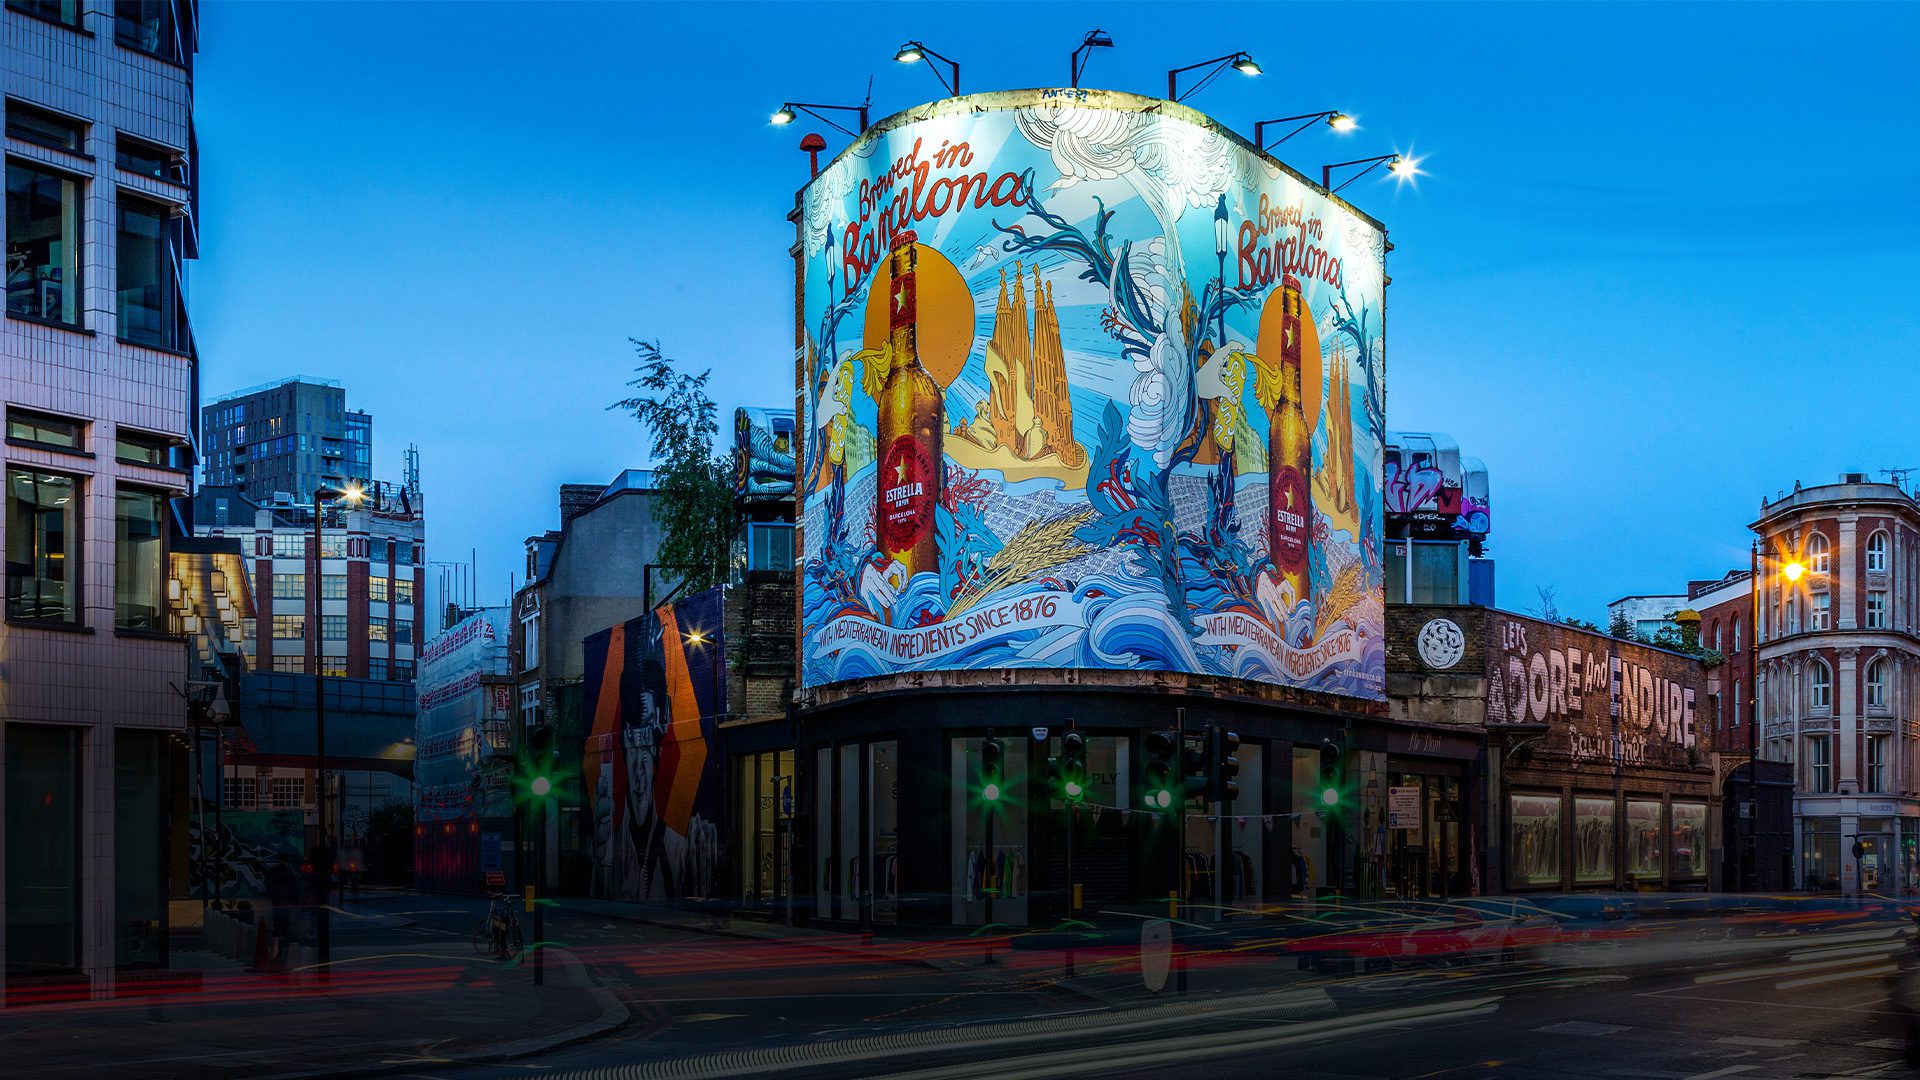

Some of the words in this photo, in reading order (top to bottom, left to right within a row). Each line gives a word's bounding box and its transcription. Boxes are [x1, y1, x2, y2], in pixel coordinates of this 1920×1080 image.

[859, 137, 922, 222] Brewed
[933, 140, 974, 168] in
[841, 160, 1031, 303] Barcelona
[1256, 193, 1304, 237] Brewed
[1308, 212, 1323, 241] in
[1234, 220, 1342, 291] Barcelona
[886, 482, 923, 503] ESTRELLA
[889, 509, 916, 521] BARCELONA
[1277, 509, 1304, 528] ESTRELLA
[820, 626, 834, 648] WITH
[834, 620, 889, 653] MEDITERRANEAN
[890, 623, 966, 659] INGREDIENTS
[966, 606, 1011, 639] SINCE
[1009, 594, 1061, 623] 1876
[1205, 616, 1227, 637] WITH
[1228, 615, 1285, 665] MEDITERRANEAN
[1284, 648, 1321, 677] INGREDIENTS
[1320, 639, 1337, 665] SINCE
[1336, 633, 1352, 654] 1876
[1488, 647, 1582, 723] ADORE
[1610, 656, 1696, 749] ENDURE
[1087, 773, 1118, 785] PLY
